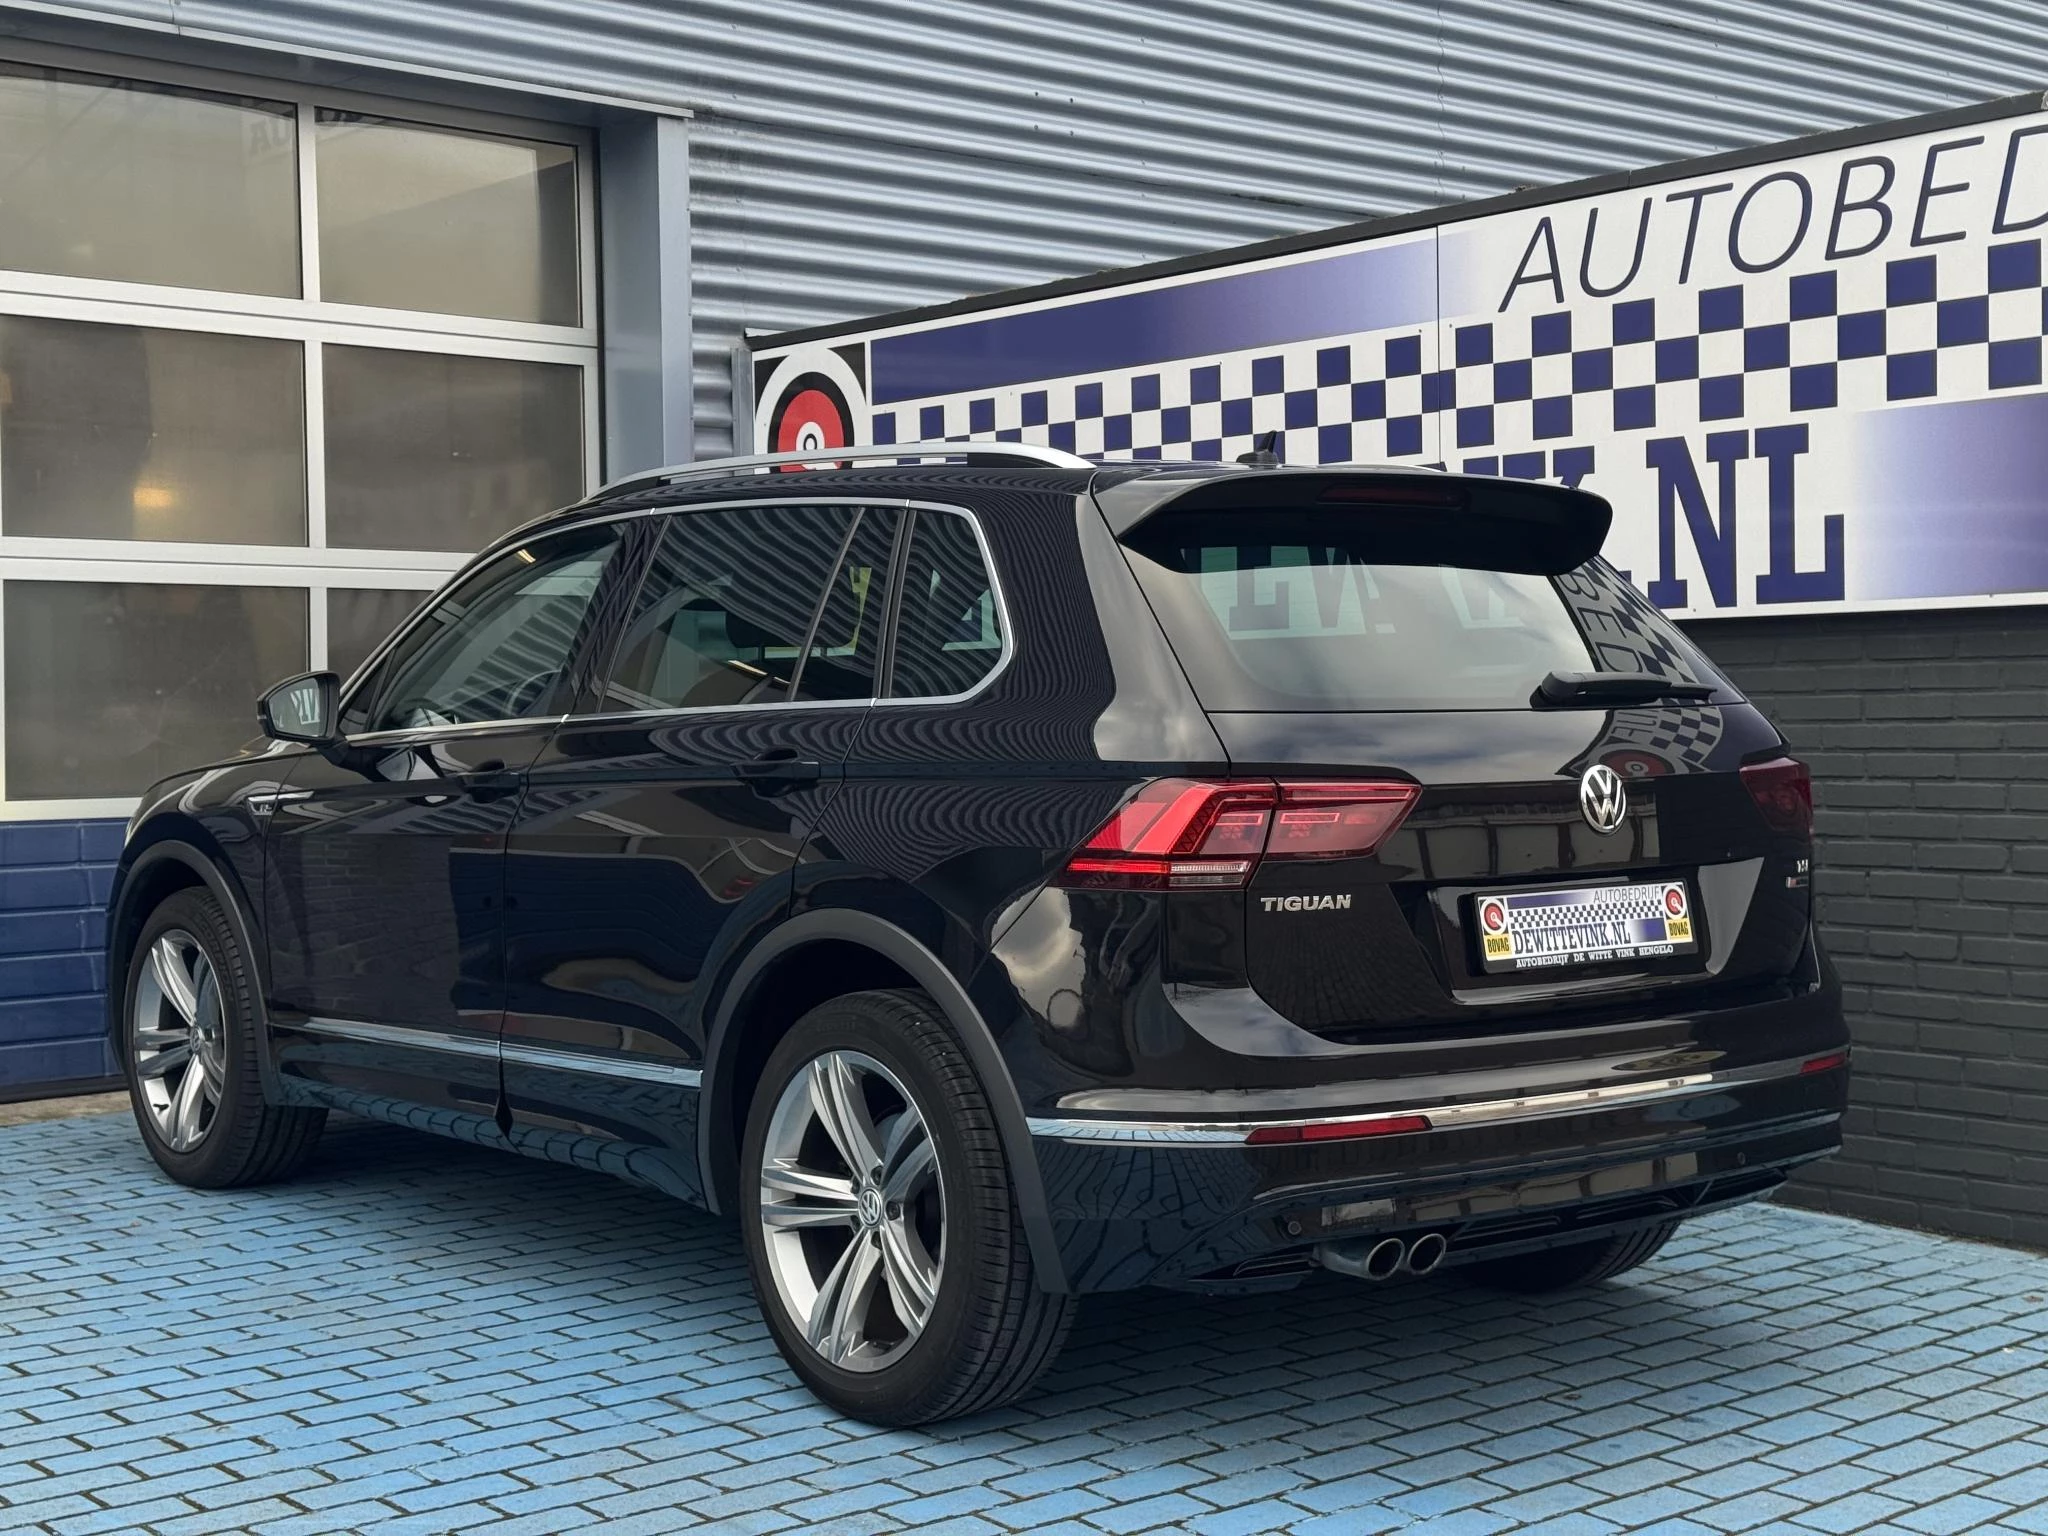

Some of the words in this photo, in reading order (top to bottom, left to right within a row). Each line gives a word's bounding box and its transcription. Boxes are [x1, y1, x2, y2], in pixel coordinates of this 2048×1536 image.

[1260, 894, 1352, 912] TIGUAN
[1593, 885, 1660, 904] AUTOBEDRIJF
[1511, 920, 1632, 955] DEWITTEVINK.NL
[1668, 921, 1690, 937] BOVAG
[1486, 938, 1510, 953] BOVAG
[1515, 954, 1569, 969] AUTOBEDRIJF
[1573, 953, 1585, 962] DE
[1588, 950, 1613, 961] WITTE
[1616, 947, 1636, 958] VINK
[1638, 944, 1674, 957] HENGELO
